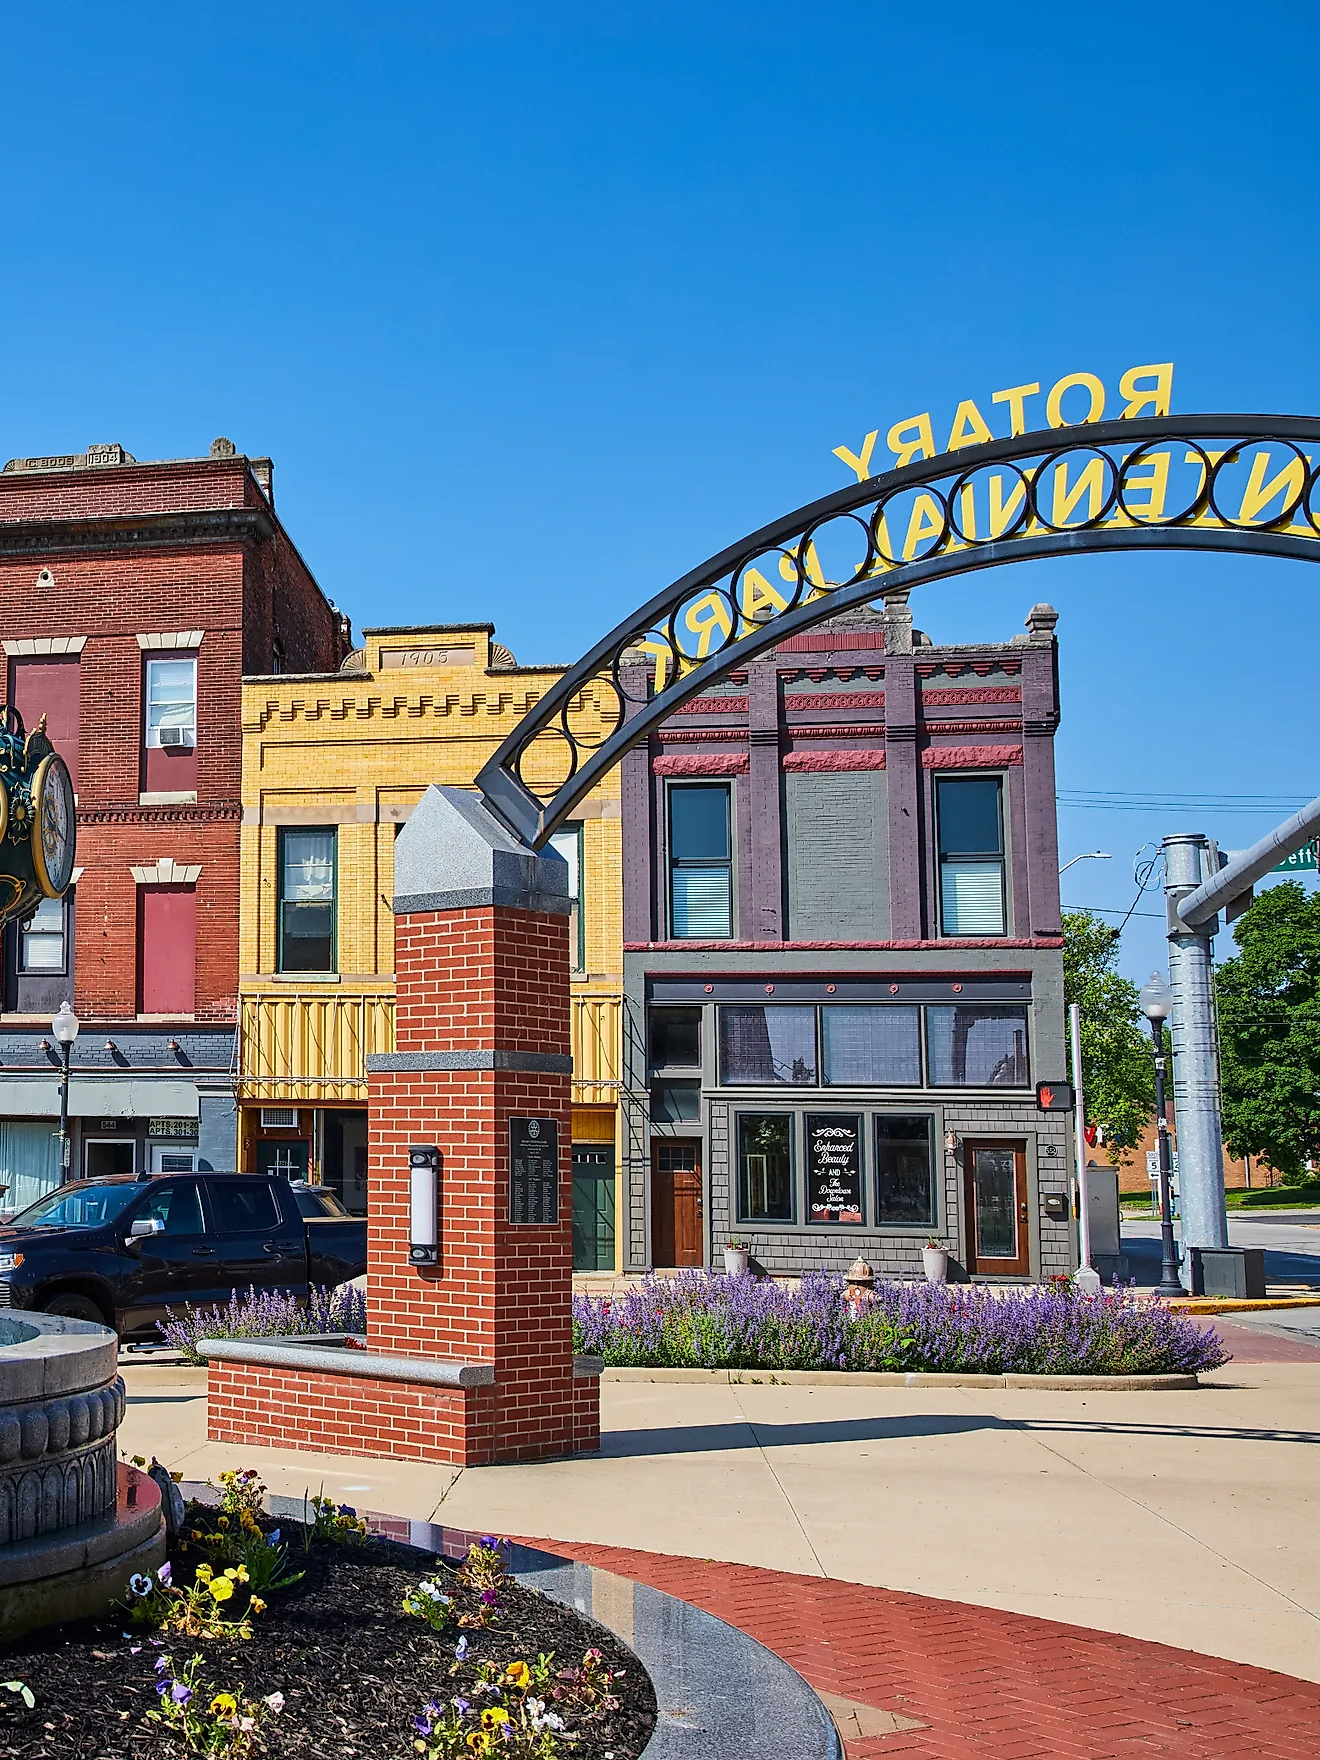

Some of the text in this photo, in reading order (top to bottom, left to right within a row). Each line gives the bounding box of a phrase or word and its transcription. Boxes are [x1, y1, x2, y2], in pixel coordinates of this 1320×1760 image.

[88, 453, 118, 465] 1904
[401, 650, 449, 666] 1905
[1279, 848, 1320, 866] eff
[102, 1121, 116, 1129] 544
[813, 1140, 854, 1152] Enhanced
[818, 1151, 849, 1165] Beauty
[828, 1168, 841, 1177] AND
[829, 1178, 840, 1188] The
[826, 1193, 844, 1203] Salon
